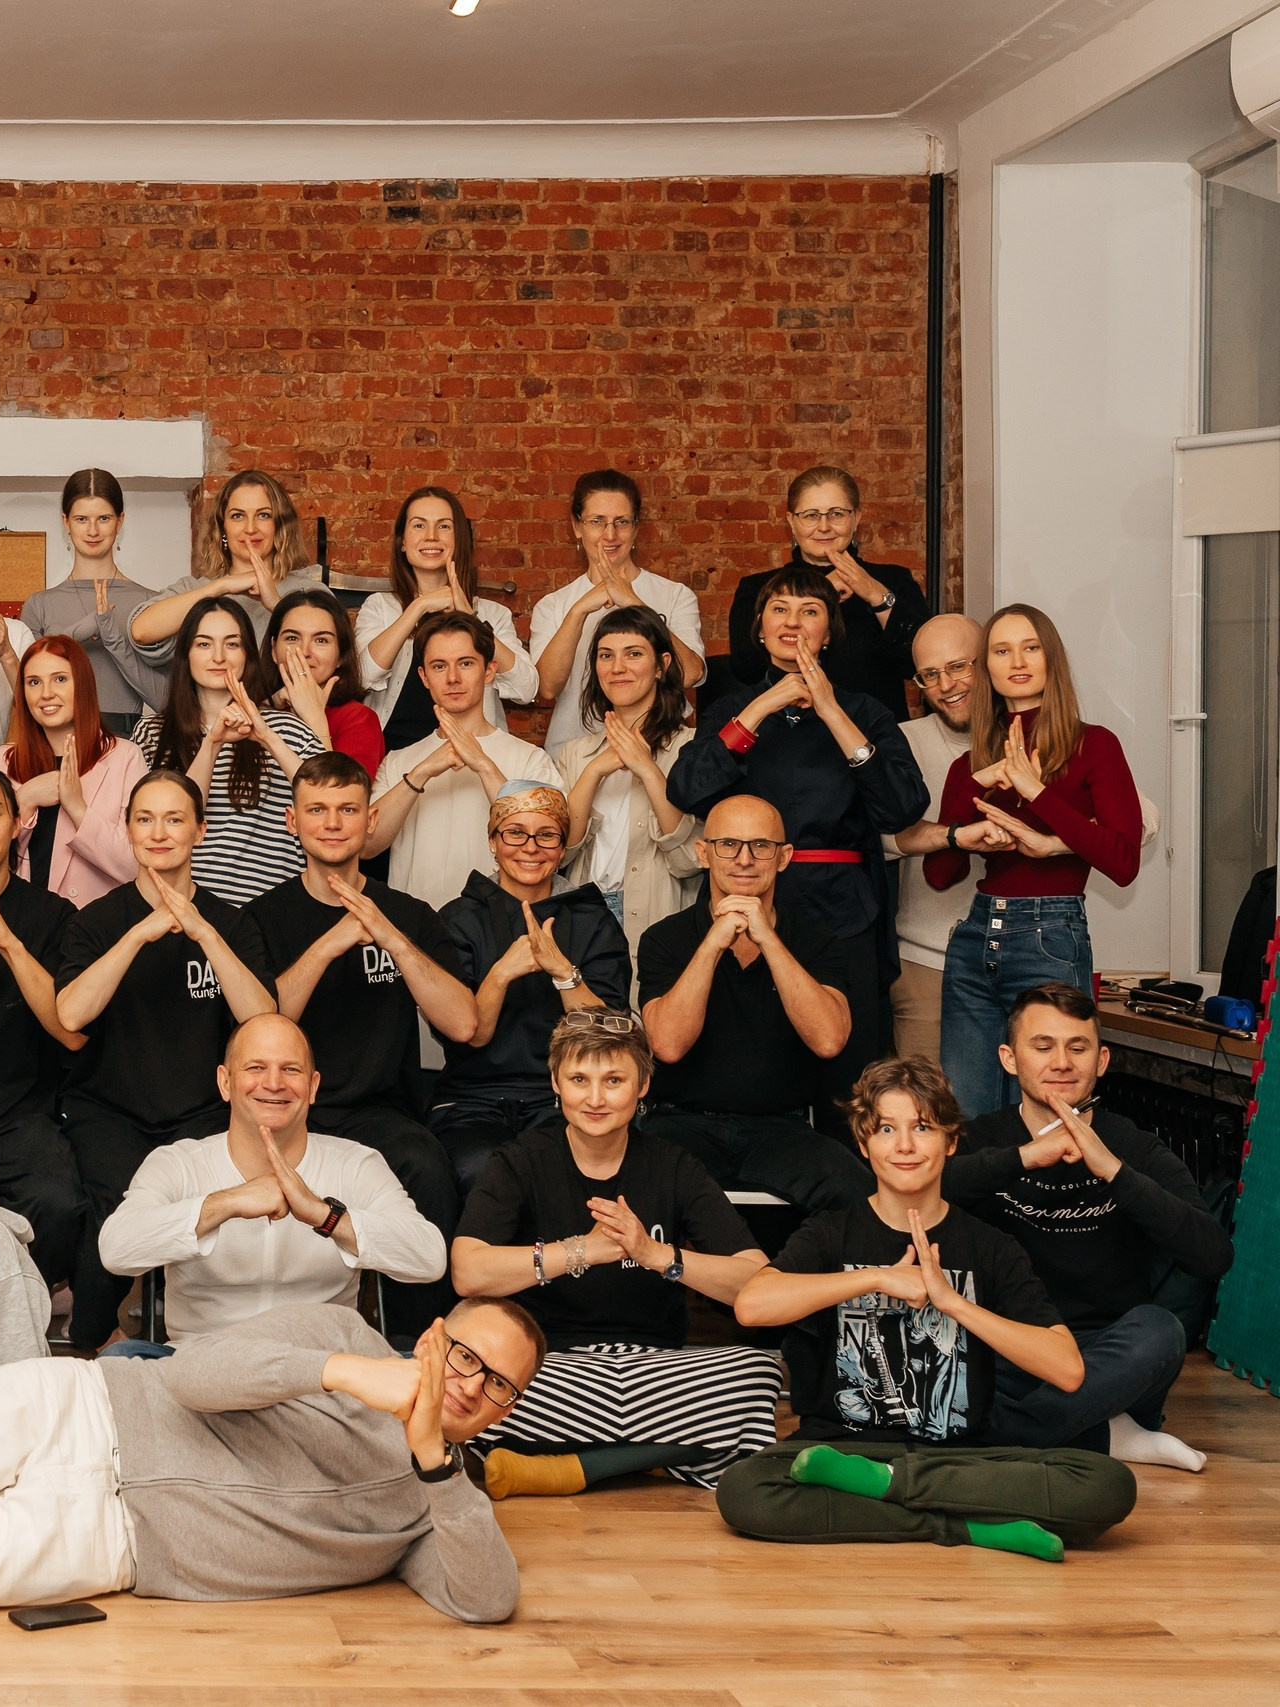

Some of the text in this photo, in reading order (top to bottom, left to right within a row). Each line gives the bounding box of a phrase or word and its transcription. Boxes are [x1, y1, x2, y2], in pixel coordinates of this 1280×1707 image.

[363, 945, 398, 974] DA
[187, 960, 220, 989] DA
[995, 1192, 1117, 1219] evermind
